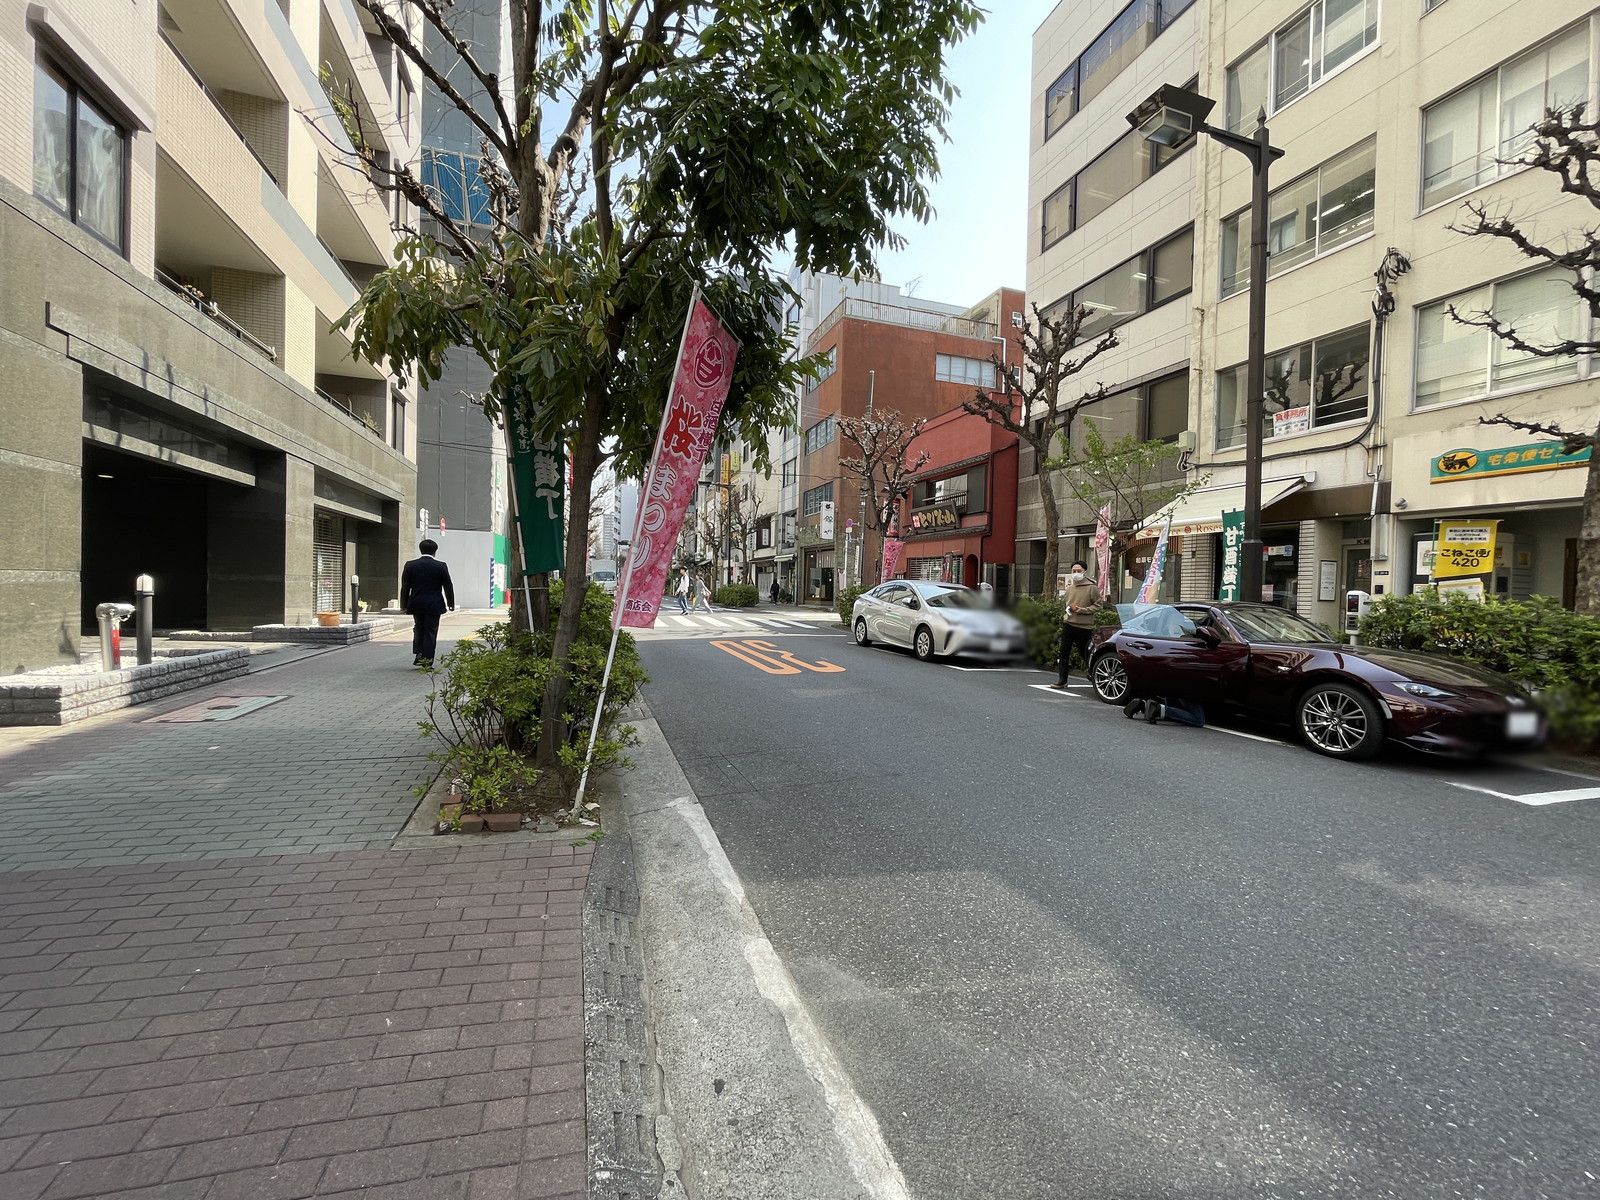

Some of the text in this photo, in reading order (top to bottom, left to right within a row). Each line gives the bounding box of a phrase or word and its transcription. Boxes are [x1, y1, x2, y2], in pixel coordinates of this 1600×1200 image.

[1487, 445, 1589, 466] 宅急便セ
[1196, 524, 1222, 533] Roses
[1441, 548, 1491, 558] こねこ便
[1451, 558, 1480, 567] 420
